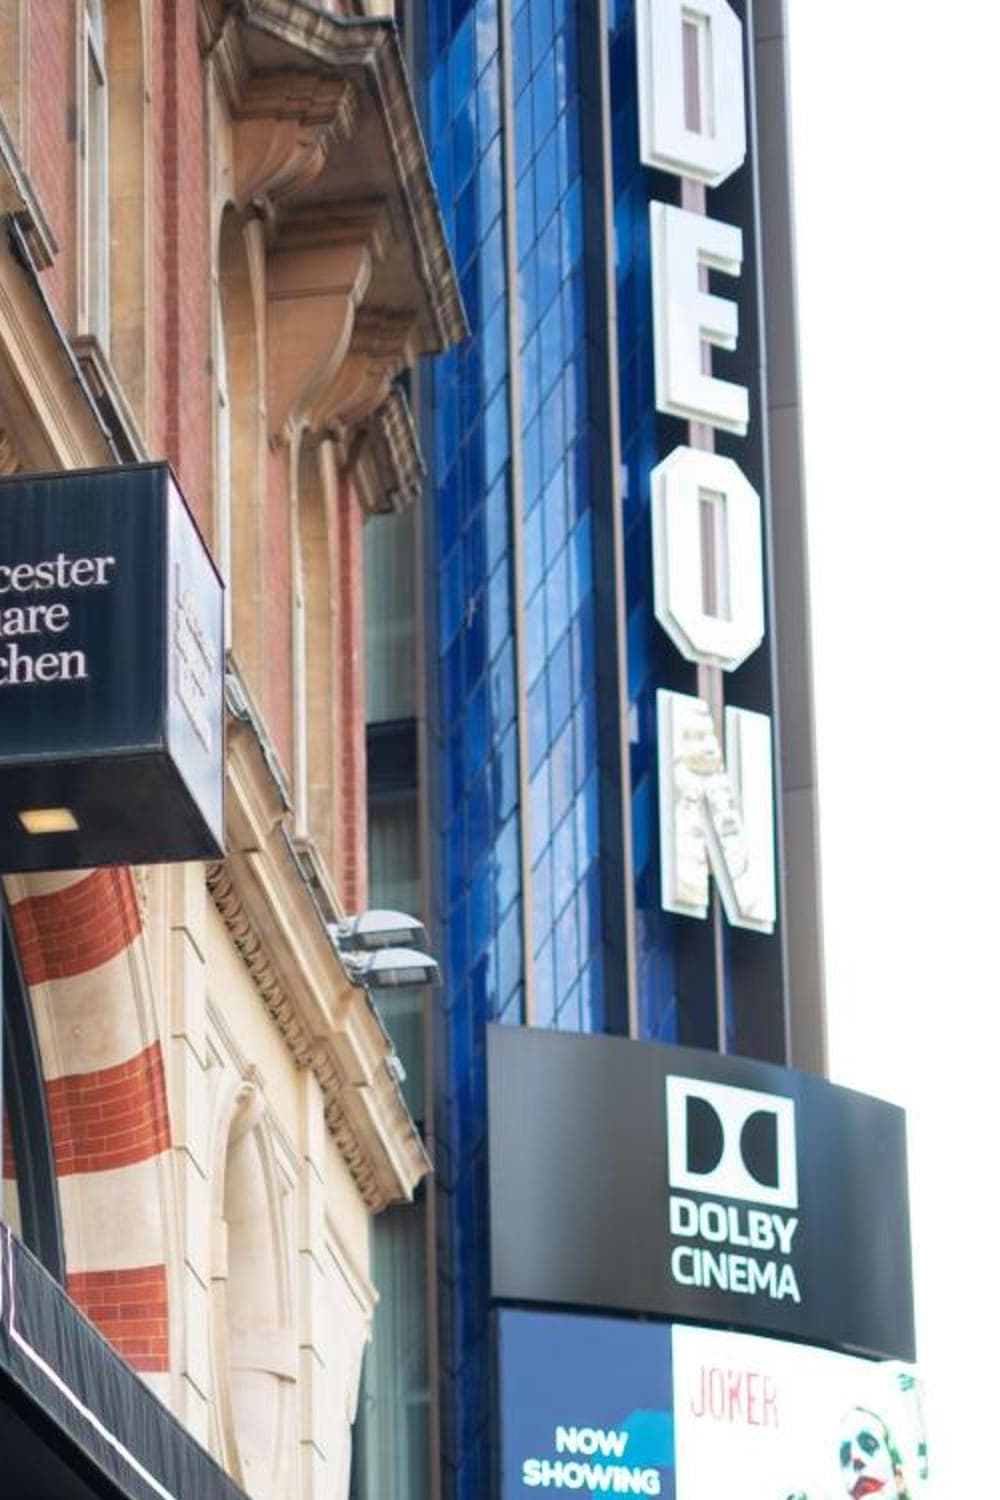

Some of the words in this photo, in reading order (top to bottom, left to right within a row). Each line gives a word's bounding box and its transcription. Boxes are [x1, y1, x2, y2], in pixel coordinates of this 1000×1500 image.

[669, 1195, 798, 1254] DOLBY
[671, 1245, 801, 1303] CINEMA
[690, 1365, 779, 1429] JOKER
[555, 1425, 629, 1457] NOW
[522, 1458, 661, 1496] SHOWING
